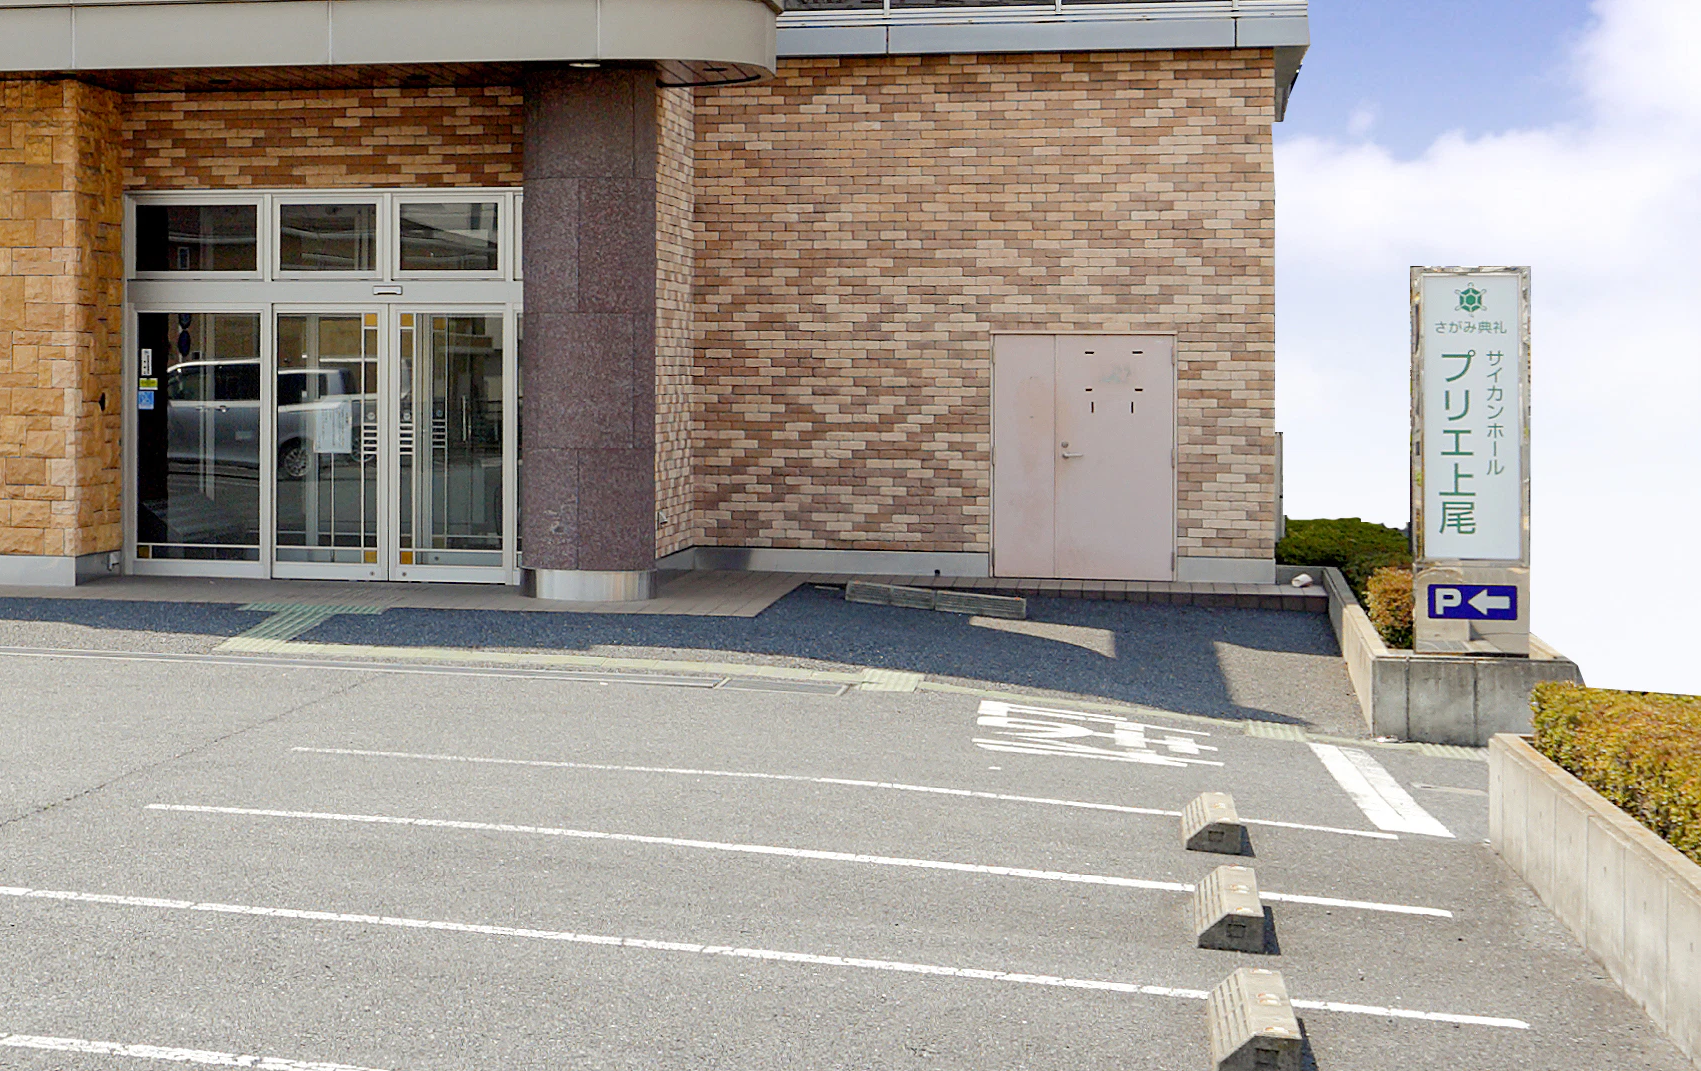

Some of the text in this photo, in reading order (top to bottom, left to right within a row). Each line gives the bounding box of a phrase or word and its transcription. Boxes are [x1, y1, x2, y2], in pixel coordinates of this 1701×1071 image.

[1434, 320, 1508, 334] さがみ典礼
[1438, 349, 1477, 535] プリエ上尾
[1485, 349, 1505, 476] サイカンホール
[1434, 587, 1463, 615] P
